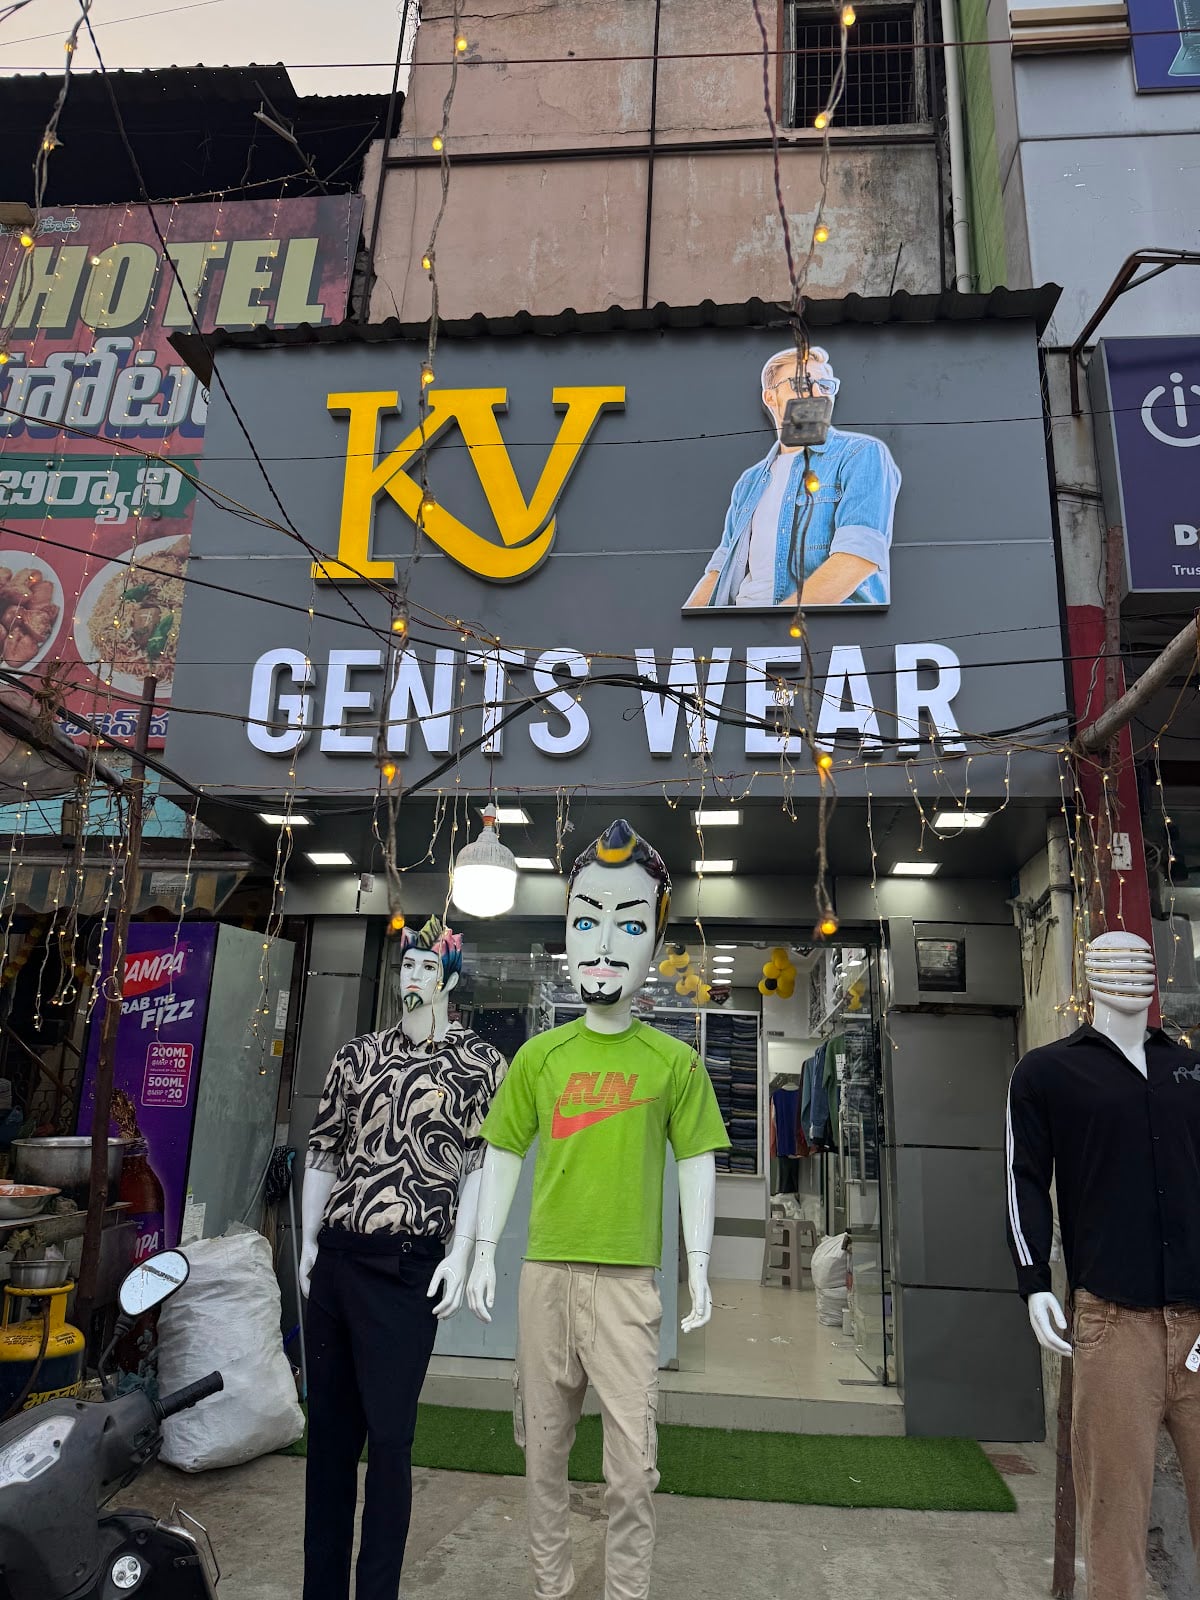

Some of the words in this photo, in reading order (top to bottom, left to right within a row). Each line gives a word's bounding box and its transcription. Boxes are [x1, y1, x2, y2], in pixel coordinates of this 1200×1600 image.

[1, 238, 325, 329] HOTEL
[311, 386, 626, 582] KV
[246, 647, 592, 757] GENTS
[635, 643, 967, 758] WEAR
[124, 951, 185, 983] AMPA
[121, 996, 151, 1015] RAB
[154, 993, 176, 1007] THE
[141, 999, 196, 1030] FIZZ
[151, 1046, 189, 1058] 200ML
[148, 1076, 185, 1088] 500ML
[560, 1071, 640, 1107] RUN
